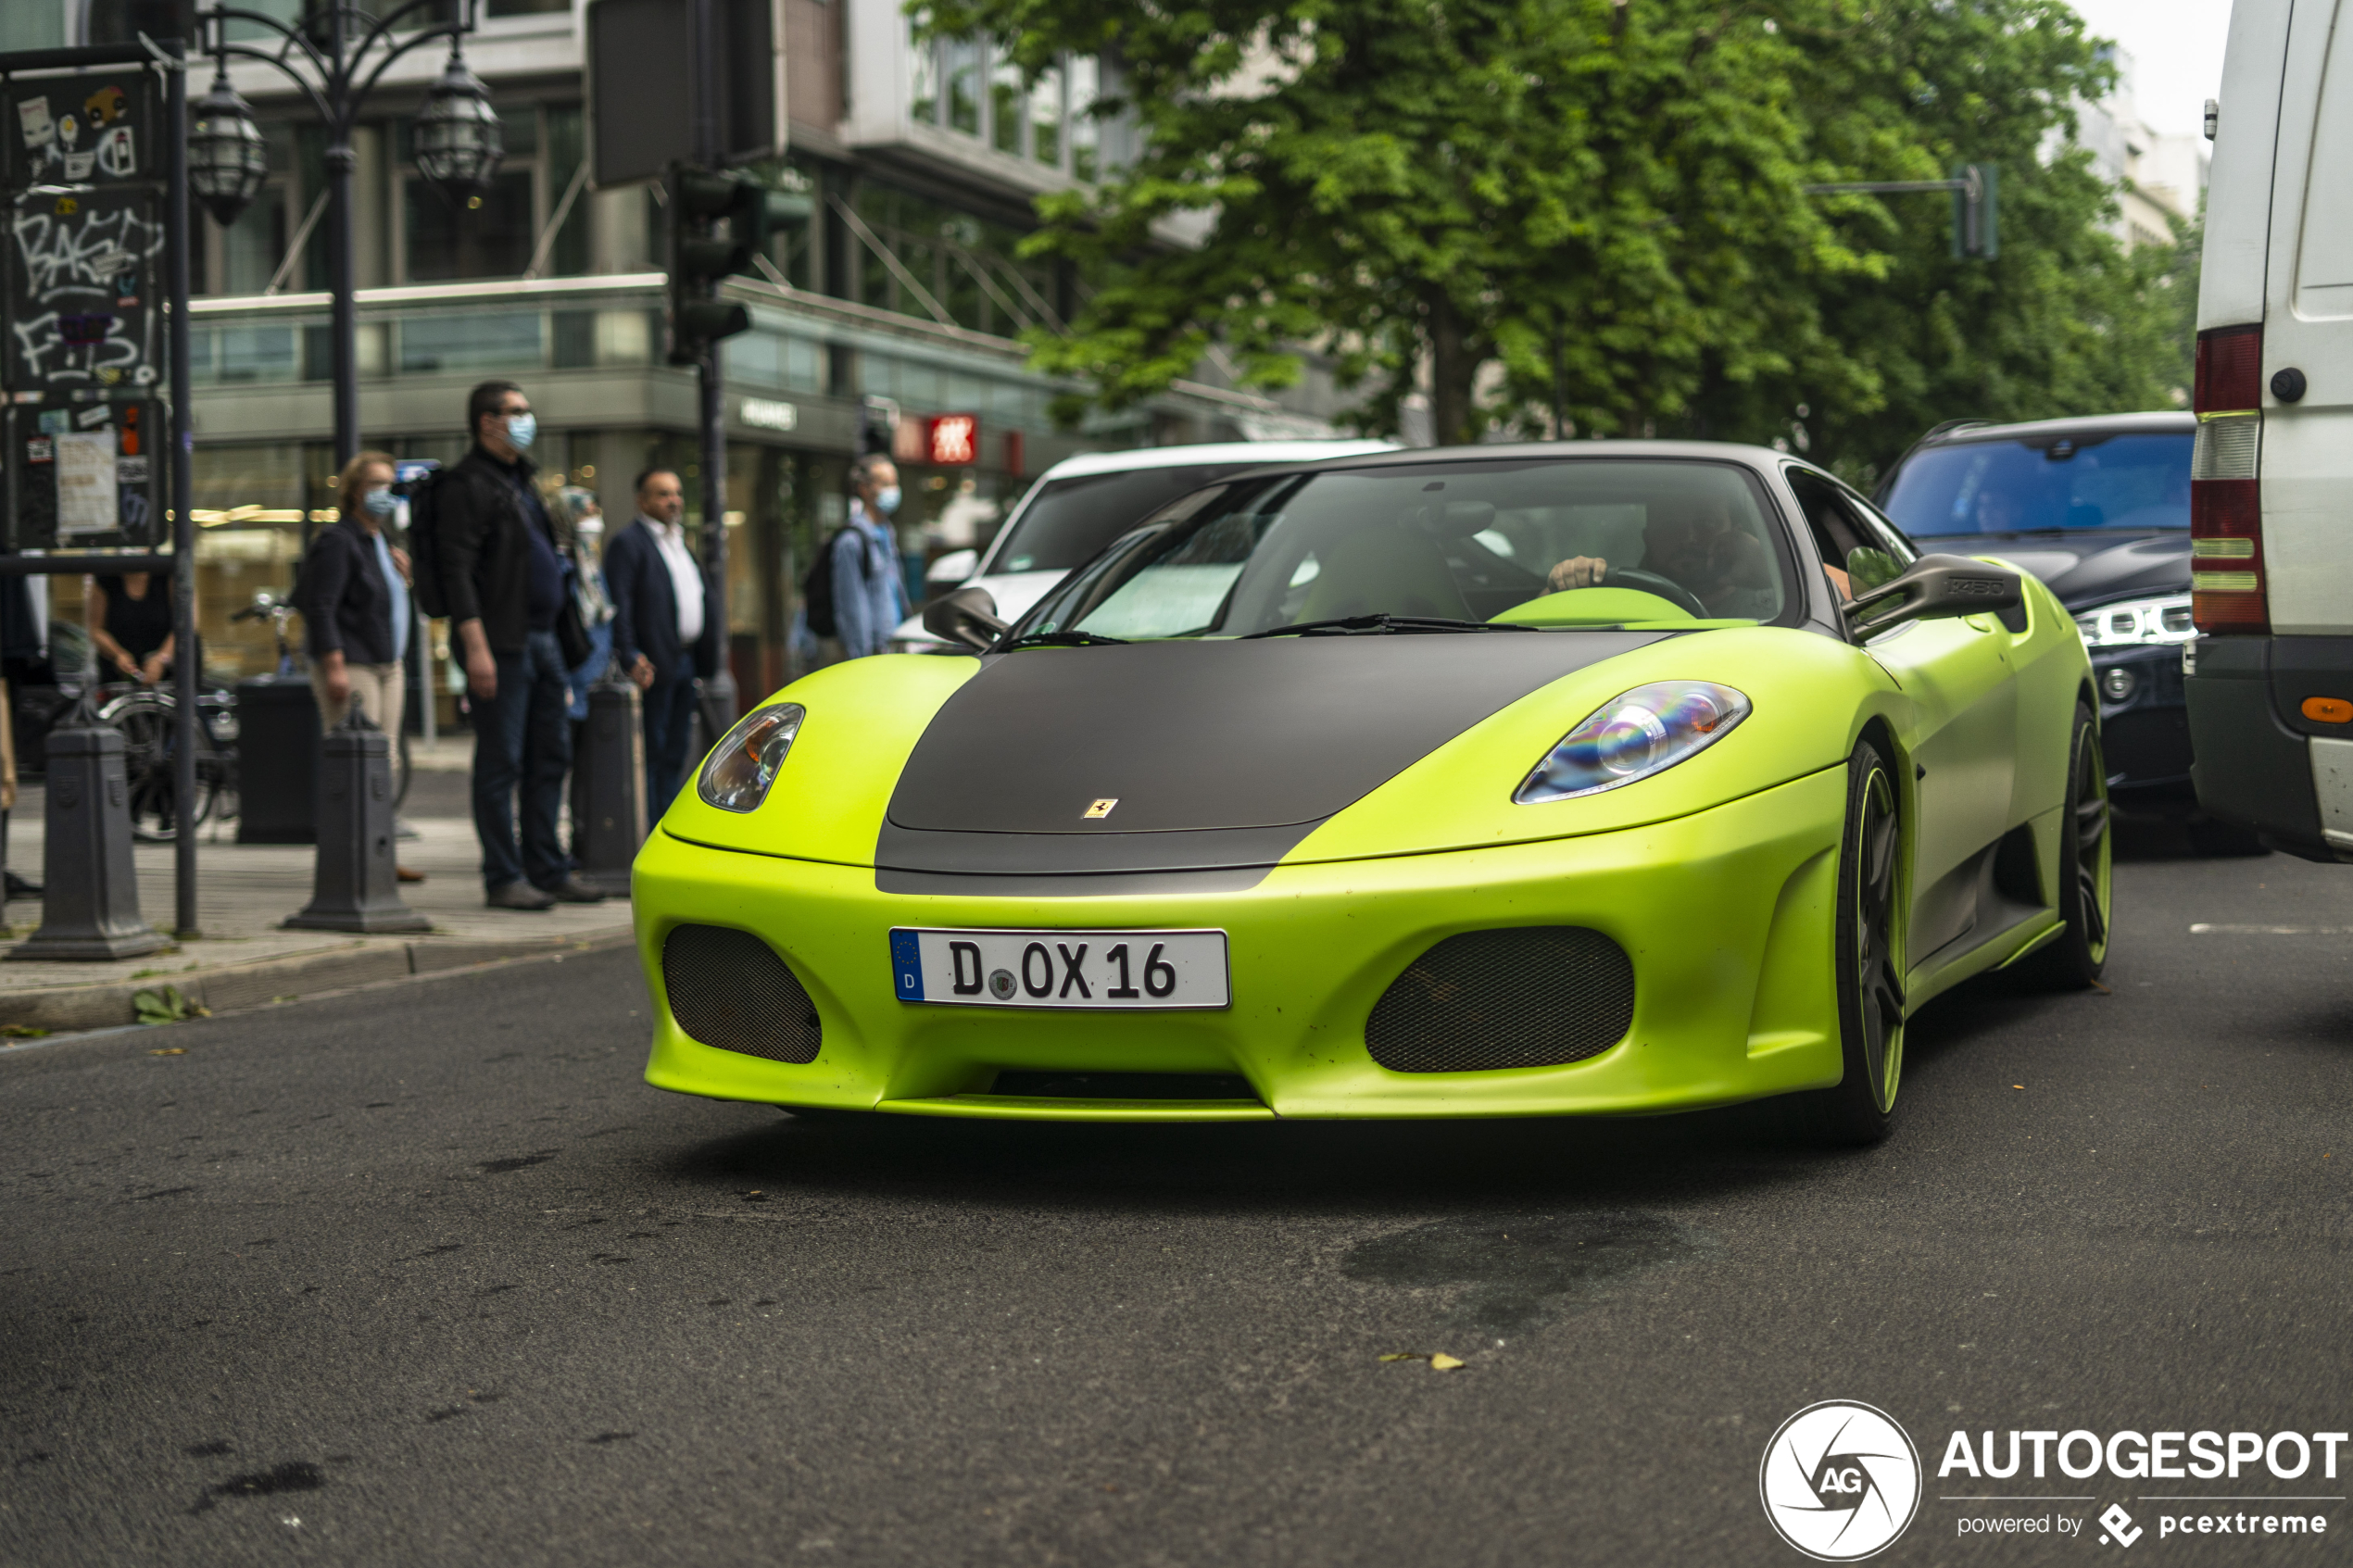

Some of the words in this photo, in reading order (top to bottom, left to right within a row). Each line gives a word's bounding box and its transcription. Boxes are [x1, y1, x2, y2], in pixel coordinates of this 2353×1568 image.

[1948, 576, 2004, 596] F430
[949, 940, 984, 996] D
[1022, 941, 1093, 998] OX
[1106, 943, 1176, 998] 16
[904, 973, 915, 988] D
